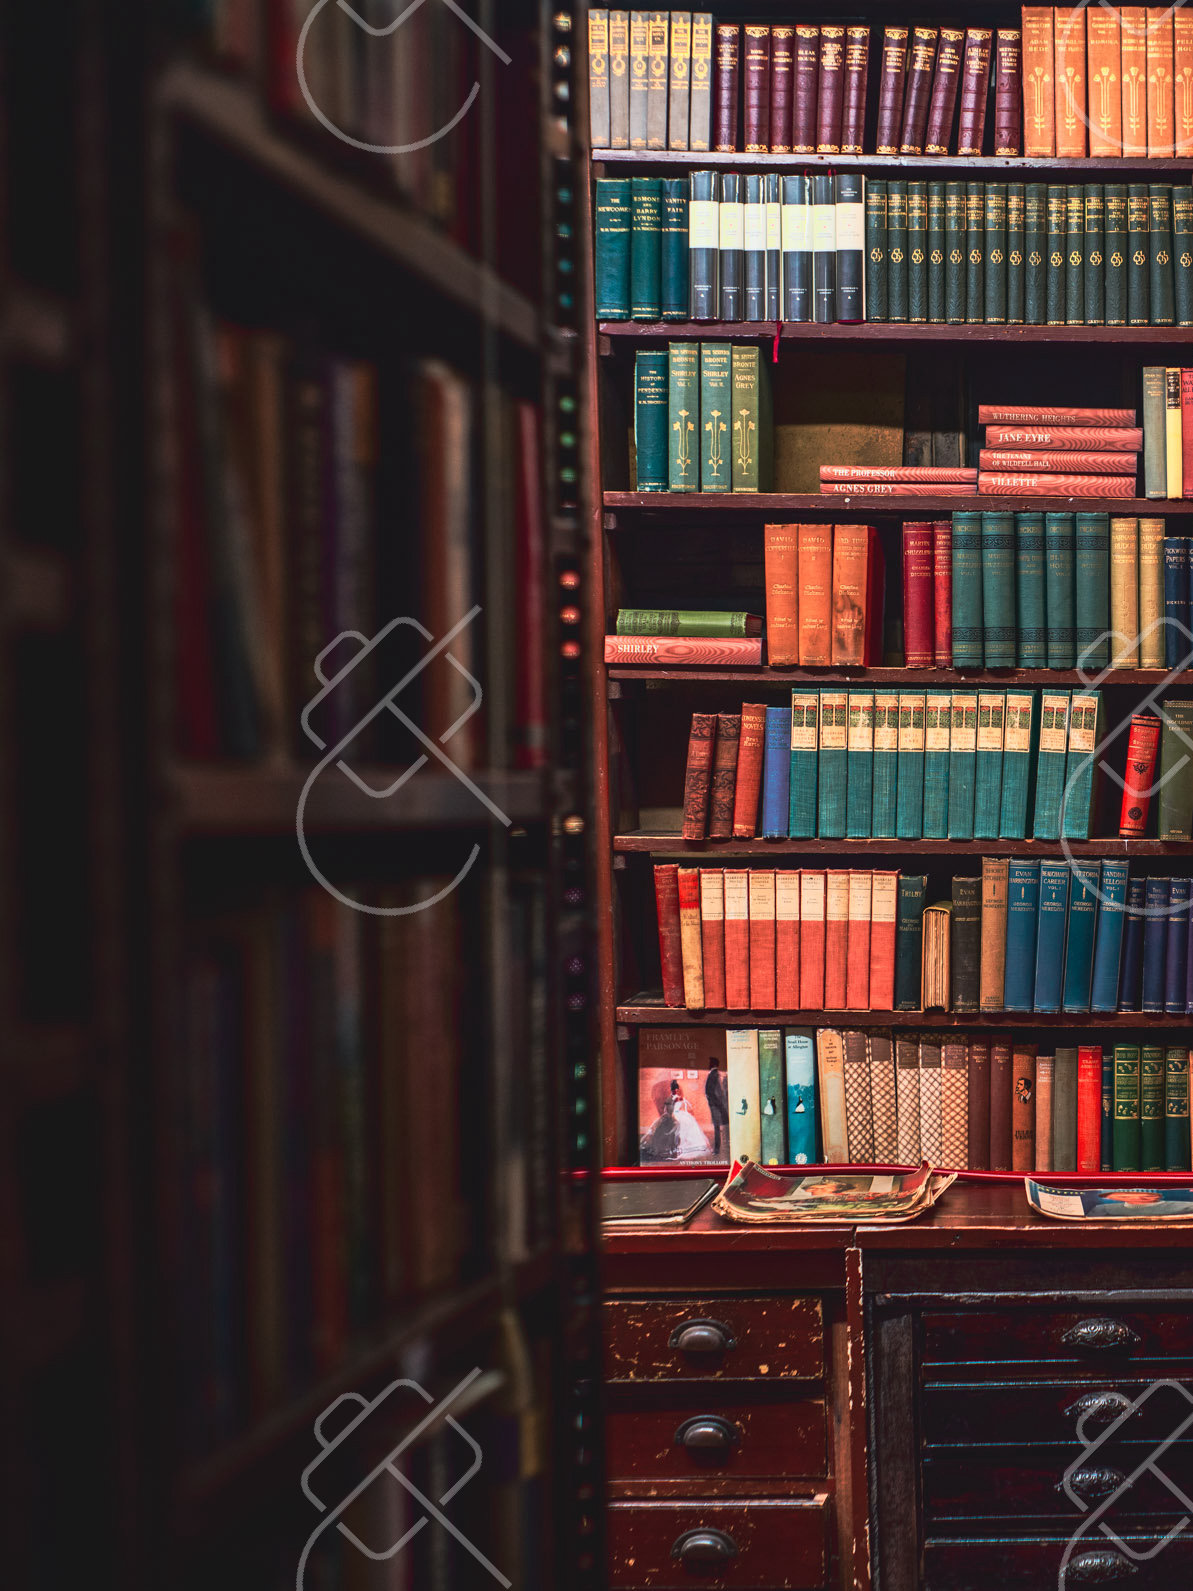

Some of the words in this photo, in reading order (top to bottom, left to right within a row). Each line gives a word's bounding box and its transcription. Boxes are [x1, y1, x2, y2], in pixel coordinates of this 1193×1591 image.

[992, 412, 1039, 421] WUTHERING
[1041, 413, 1077, 422] HEIGHTS
[998, 433, 1023, 442] JANE
[1025, 433, 1051, 442] EYRE
[991, 477, 1038, 486] VILLETTE
[833, 484, 865, 492] AGNES
[867, 485, 894, 493] GREY
[617, 645, 659, 653] SHIRLEY
[901, 889, 923, 898] TRILBY
[646, 1033, 692, 1041] FRAMLEY
